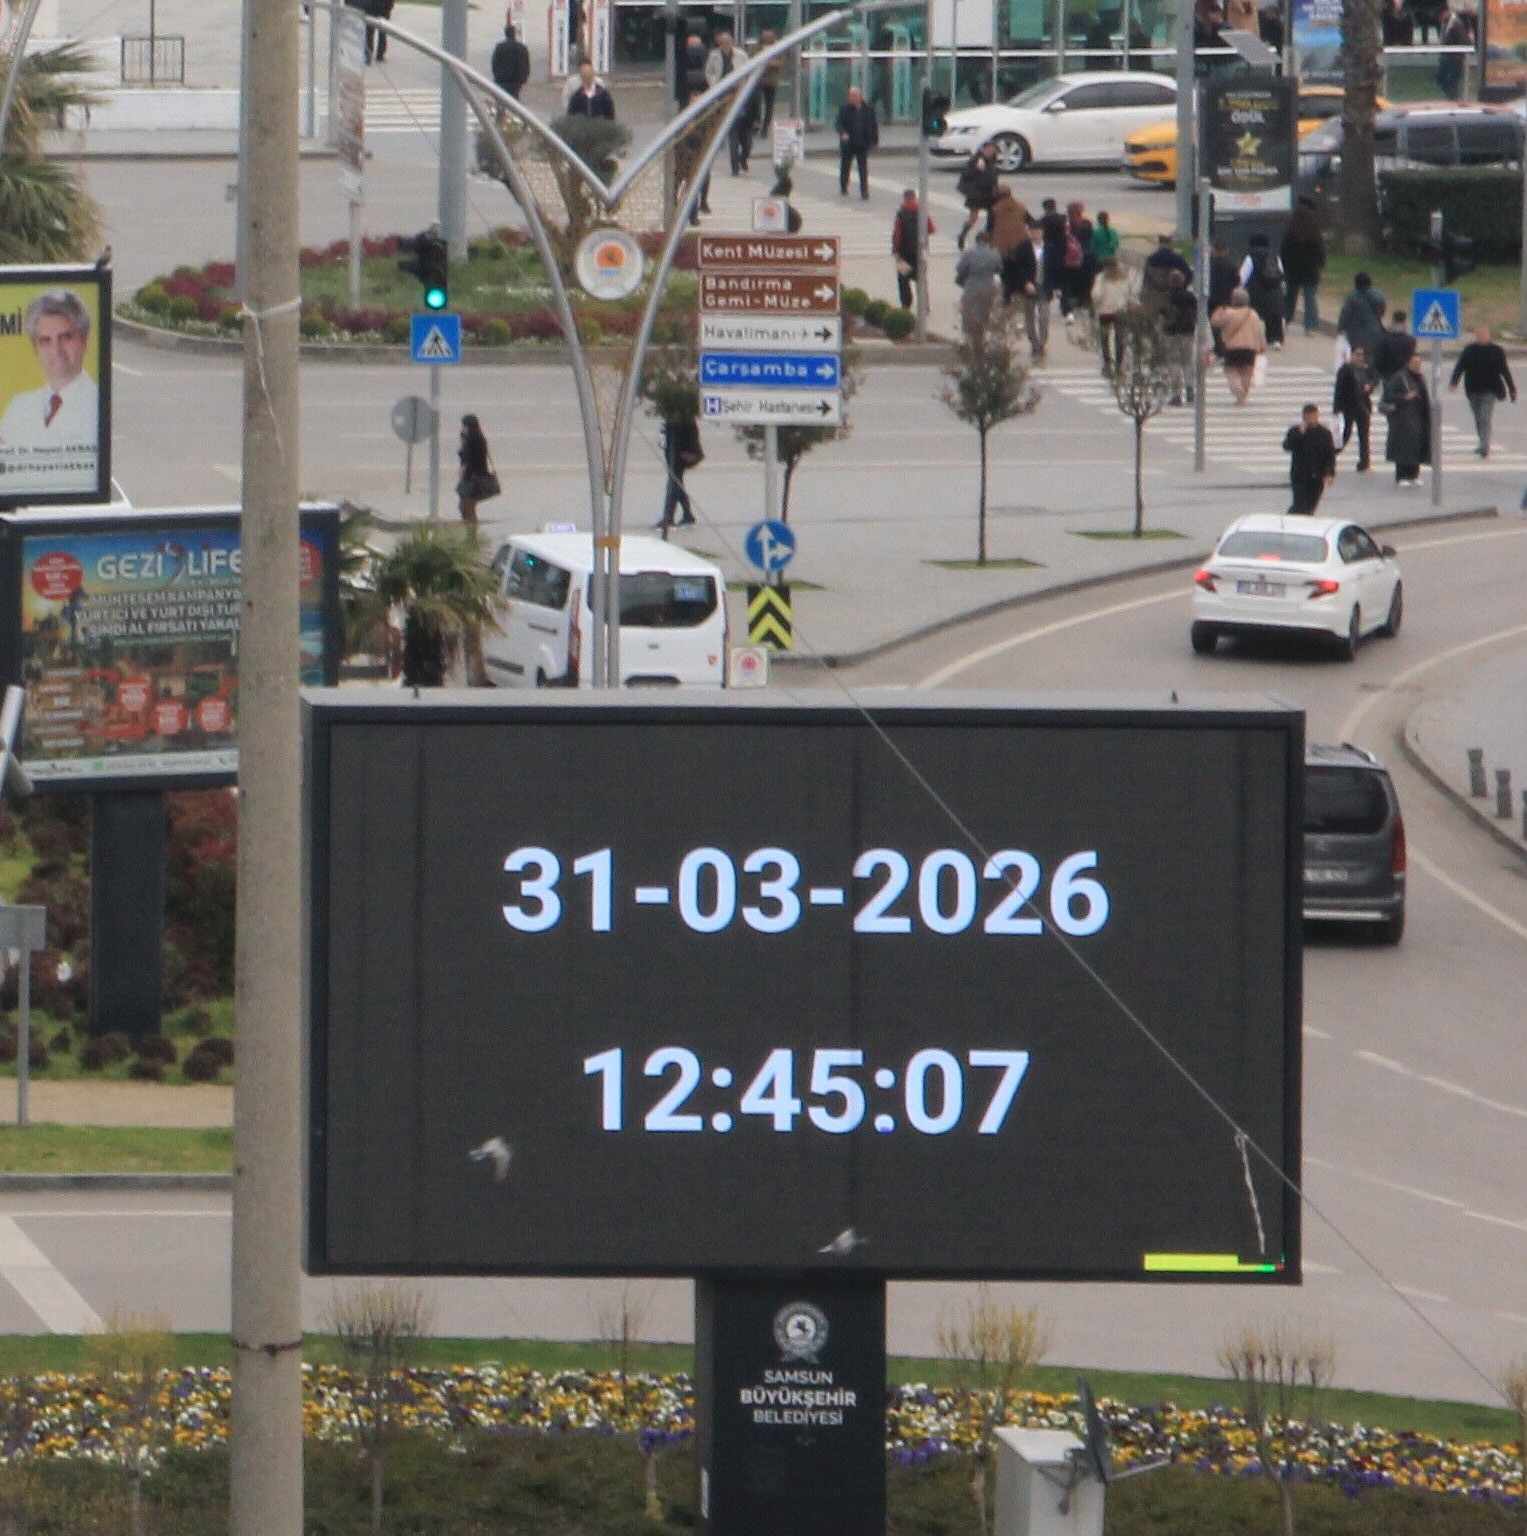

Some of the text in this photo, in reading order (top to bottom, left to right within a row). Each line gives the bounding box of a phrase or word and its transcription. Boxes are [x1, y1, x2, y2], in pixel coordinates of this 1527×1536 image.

[703, 242, 808, 259] Kent Müzesi
[705, 277, 792, 291] Bandırma
[705, 360, 808, 377] Çarşamba
[502, 846, 1109, 939] 31-03-2026
[584, 1047, 1030, 1135] 12:45:07
[764, 1370, 833, 1384] SAMSUN
[740, 1386, 856, 1408] BÜYÜKŞEHİR
[753, 1409, 843, 1425] BELEDİYESİ
